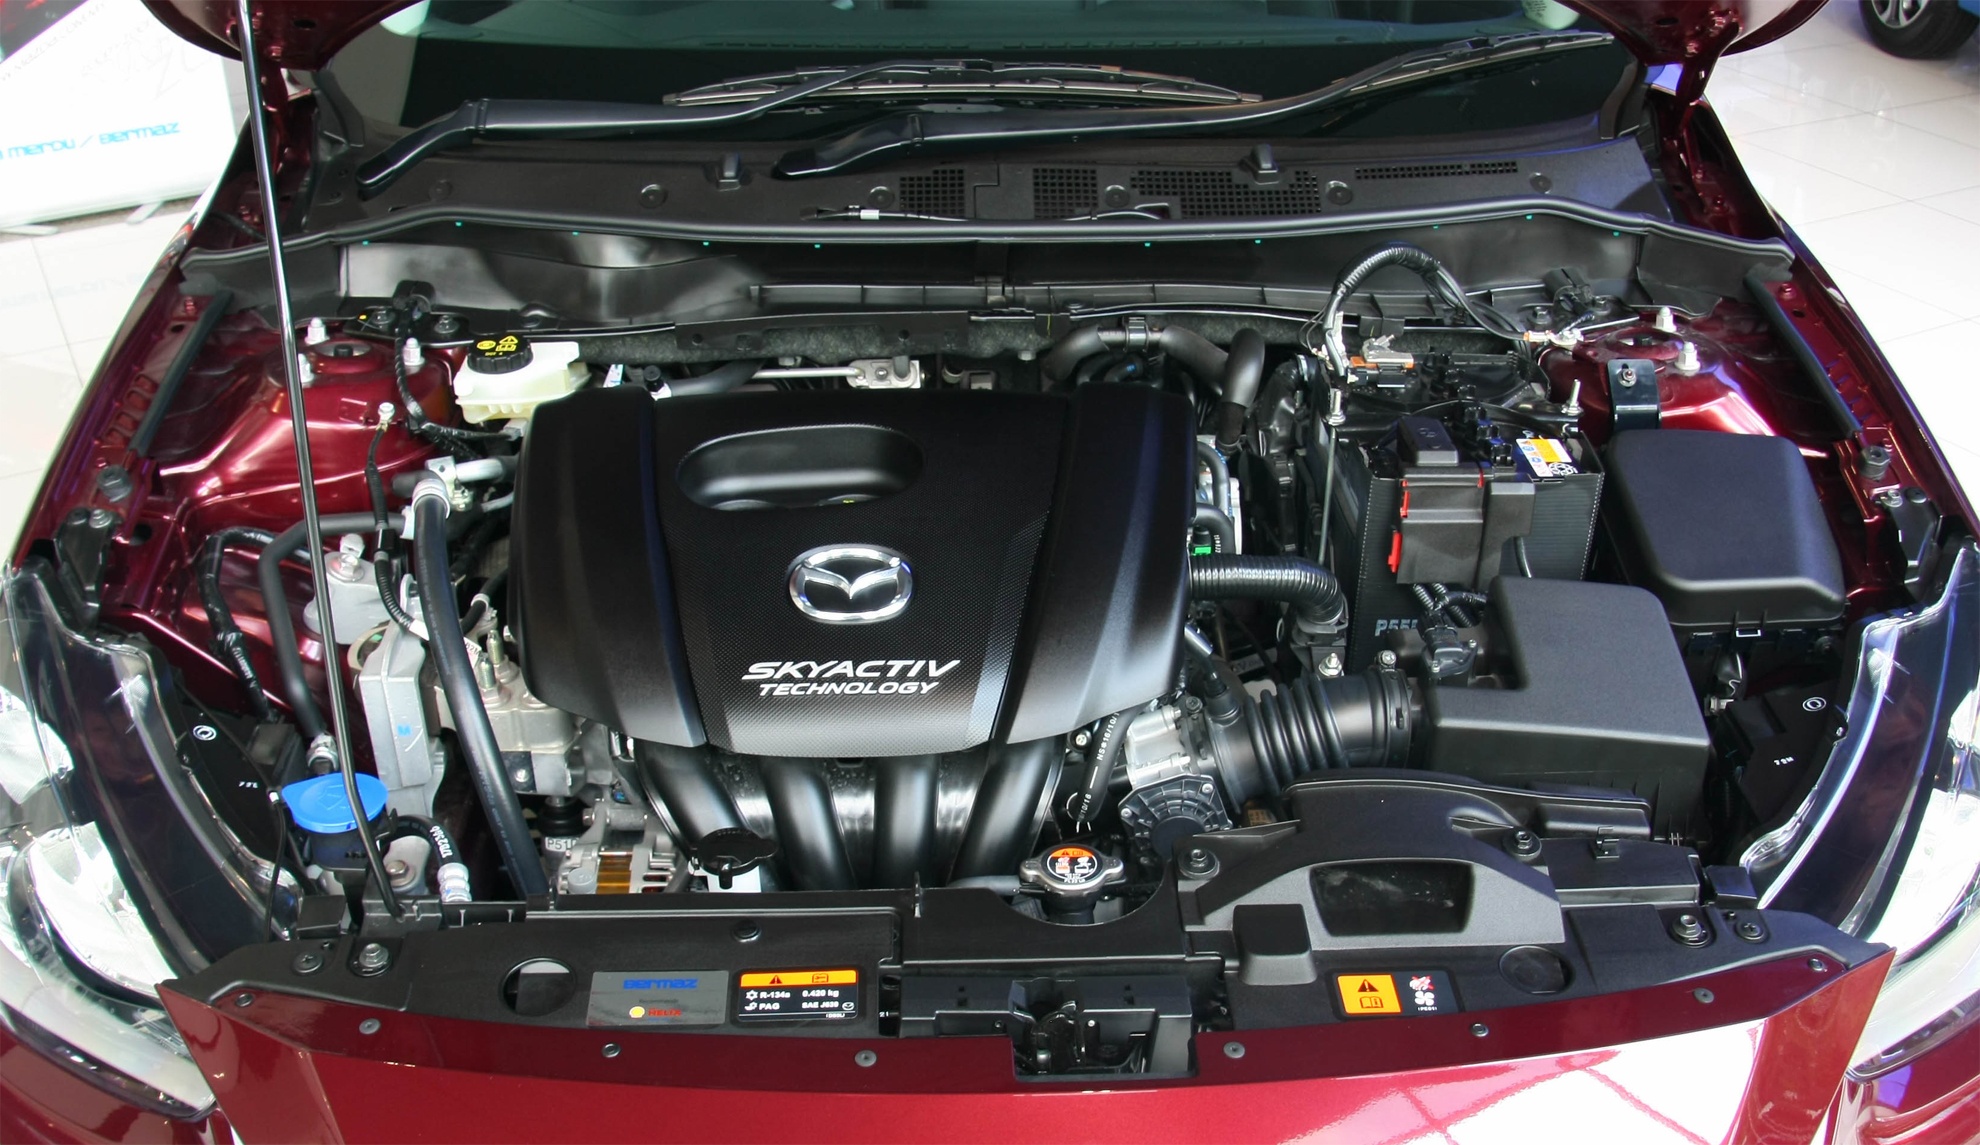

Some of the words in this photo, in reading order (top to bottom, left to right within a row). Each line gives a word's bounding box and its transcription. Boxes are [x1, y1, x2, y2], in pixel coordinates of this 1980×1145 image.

[741, 659, 961, 680] SKYACTIV
[759, 681, 939, 696] TECHNOLOGY
[759, 990, 791, 999] R-134a
[827, 988, 840, 998] kg
[758, 1002, 781, 1011] PAG
